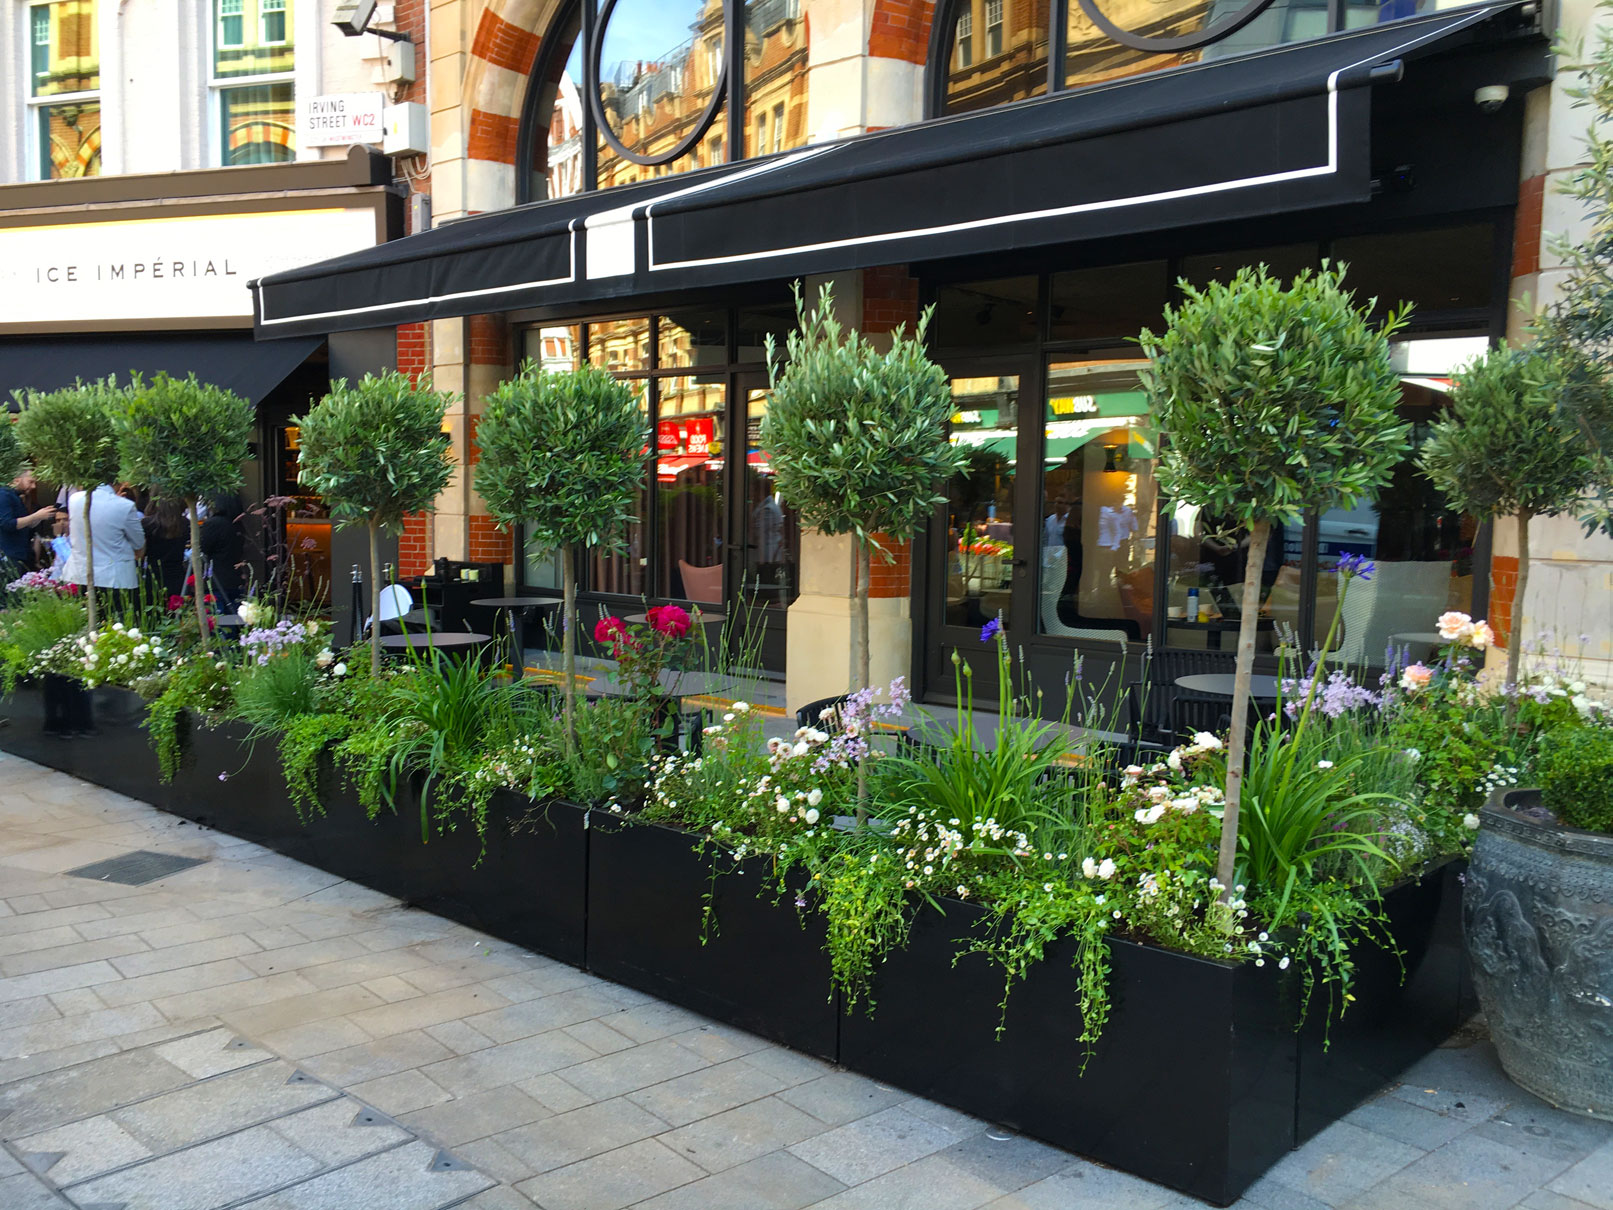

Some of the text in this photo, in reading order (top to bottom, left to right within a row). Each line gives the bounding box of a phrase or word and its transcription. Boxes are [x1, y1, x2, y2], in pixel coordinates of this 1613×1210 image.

[308, 100, 345, 114] IRVING
[309, 113, 376, 130] STREET WC2
[36, 256, 238, 283] ICE IMPÉRIAL
